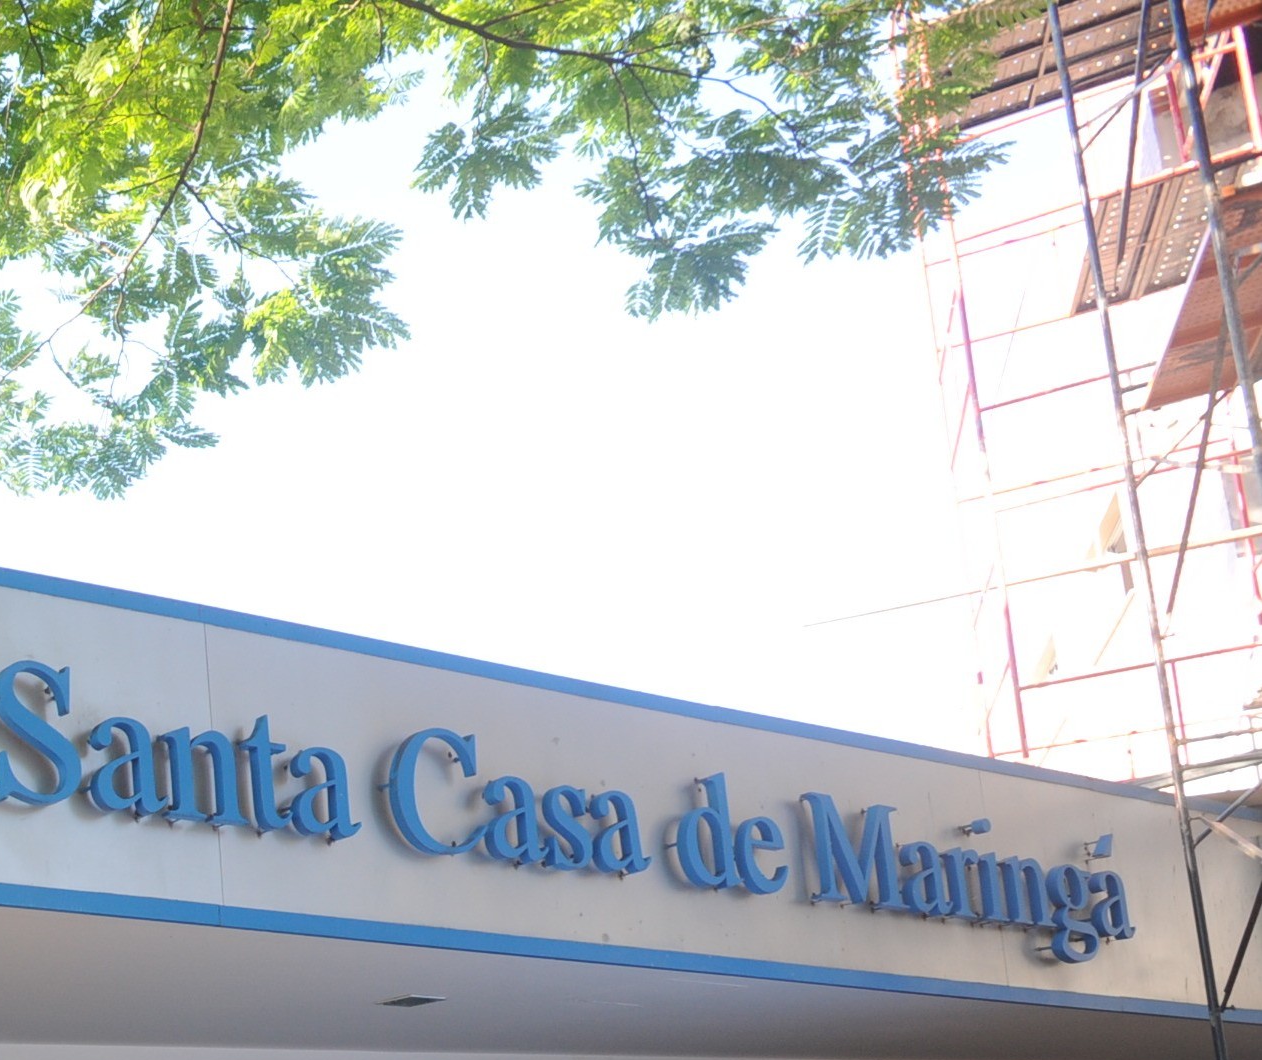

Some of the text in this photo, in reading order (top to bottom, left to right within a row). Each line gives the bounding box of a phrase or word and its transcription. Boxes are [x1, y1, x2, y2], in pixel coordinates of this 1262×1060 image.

[389, 727, 652, 875] Casa
[676, 772, 789, 895] de
[800, 791, 1136, 963] Maringá
